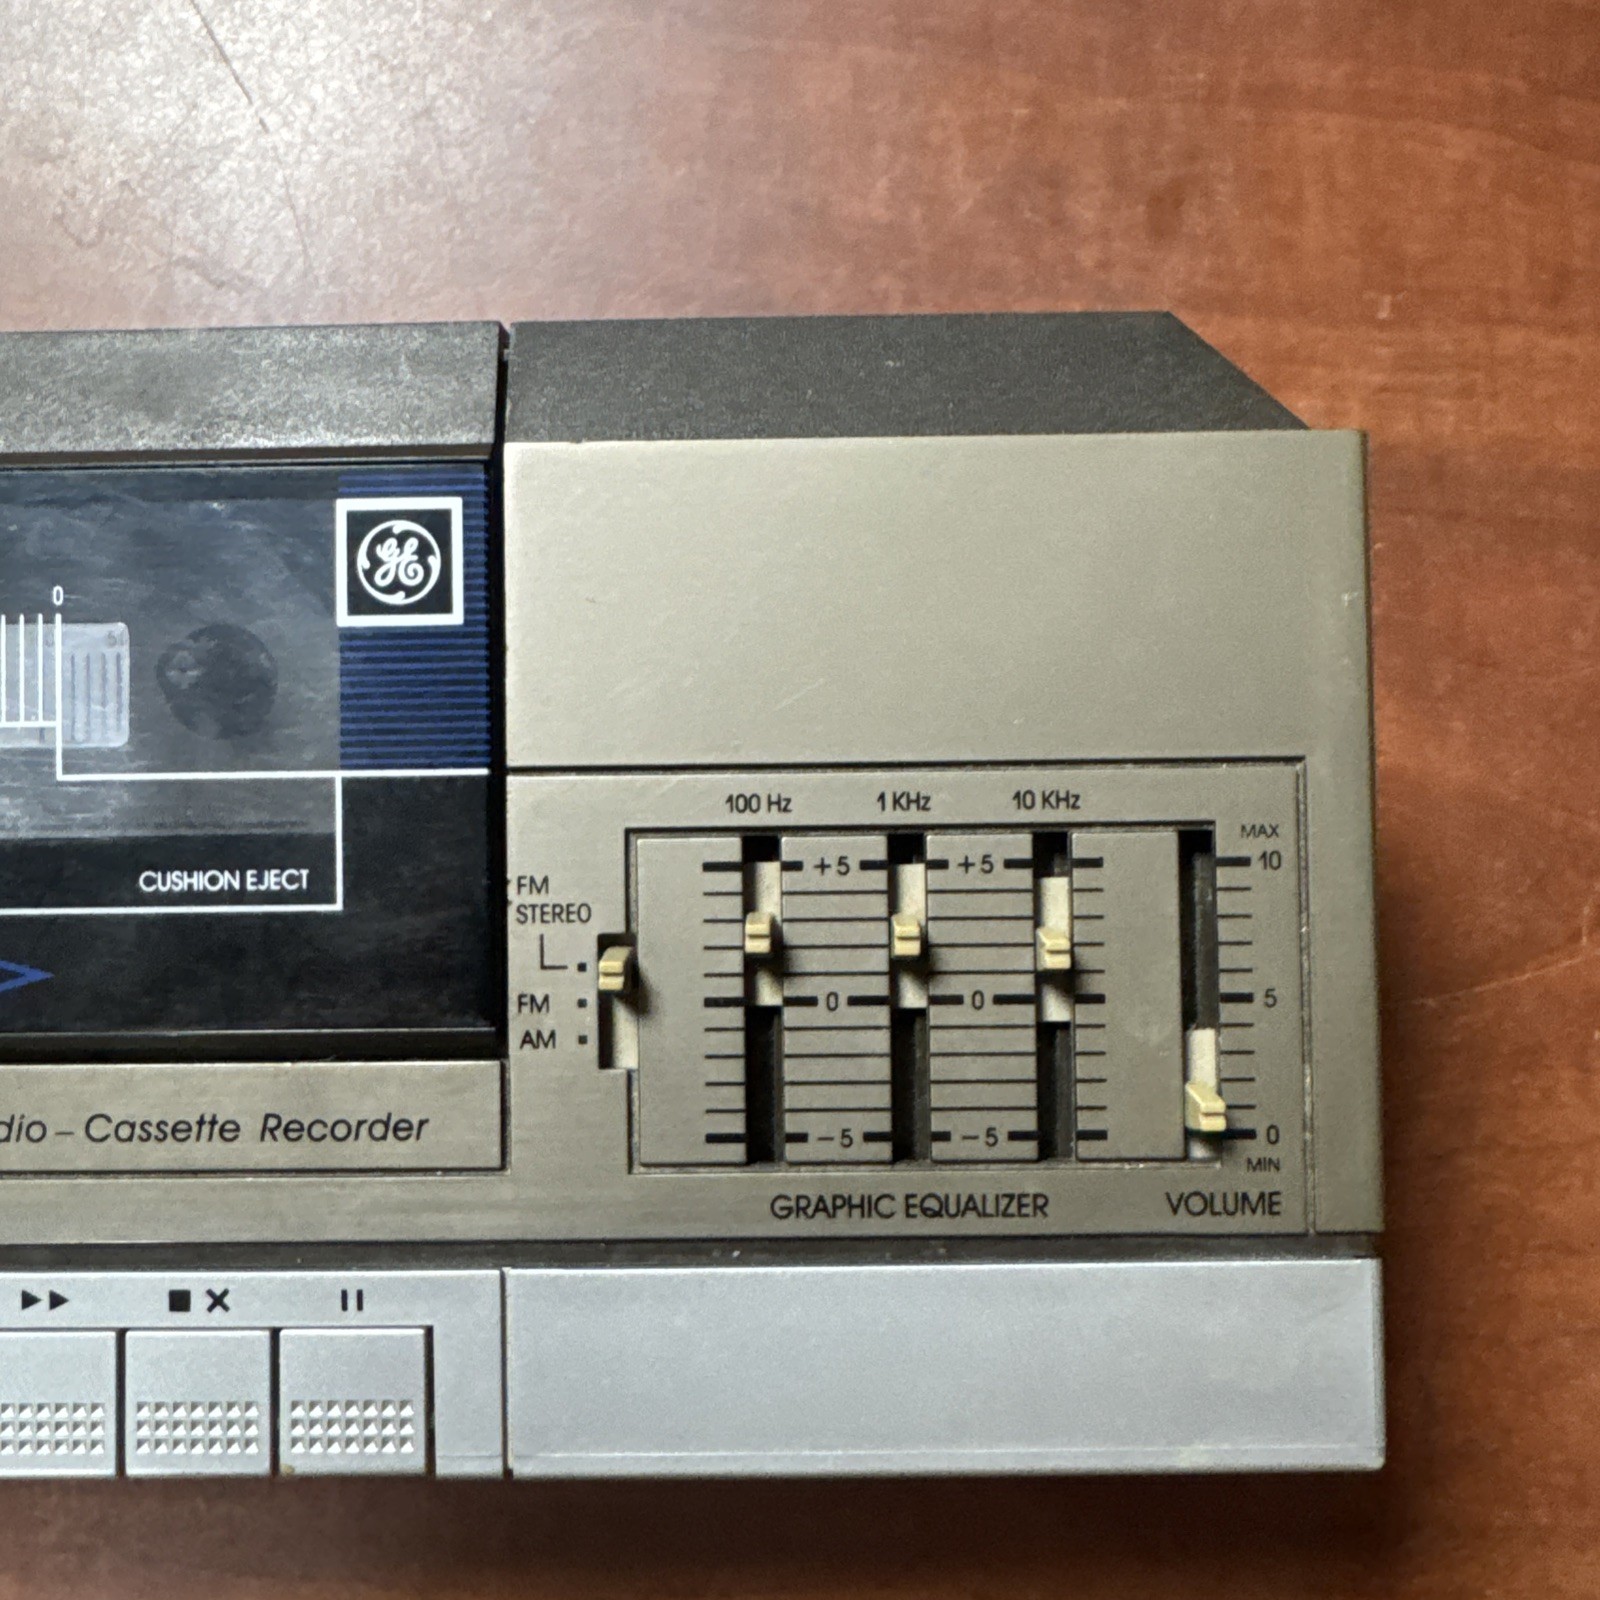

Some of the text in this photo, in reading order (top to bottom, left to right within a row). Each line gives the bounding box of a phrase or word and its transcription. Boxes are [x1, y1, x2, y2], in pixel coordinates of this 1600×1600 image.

[51, 585, 64, 607] 0
[725, 793, 793, 814] 100 Hz
[876, 791, 932, 812] 1 KHz
[1012, 789, 1081, 811] 10 KHz
[1240, 823, 1280, 839] MAX
[813, 855, 851, 876] +5
[957, 854, 994, 875] +5
[1258, 850, 1282, 871] 10
[138, 868, 310, 892] CUSHION EJECT
[516, 875, 550, 895] FM
[515, 903, 592, 924] STEREO
[517, 993, 550, 1014] FM
[825, 991, 839, 1013] 0
[971, 989, 985, 1011] 0
[1263, 987, 1278, 1009] 5
[519, 1029, 556, 1050] AM
[84, 1113, 241, 1143] Cassette
[259, 1112, 430, 1143] Recorder
[1266, 1123, 1280, 1146] 0
[1246, 1156, 1281, 1173] MIN
[770, 1192, 1050, 1221] GRAPHIC EQUALIZER
[1164, 1190, 1282, 1217] VOLUME
